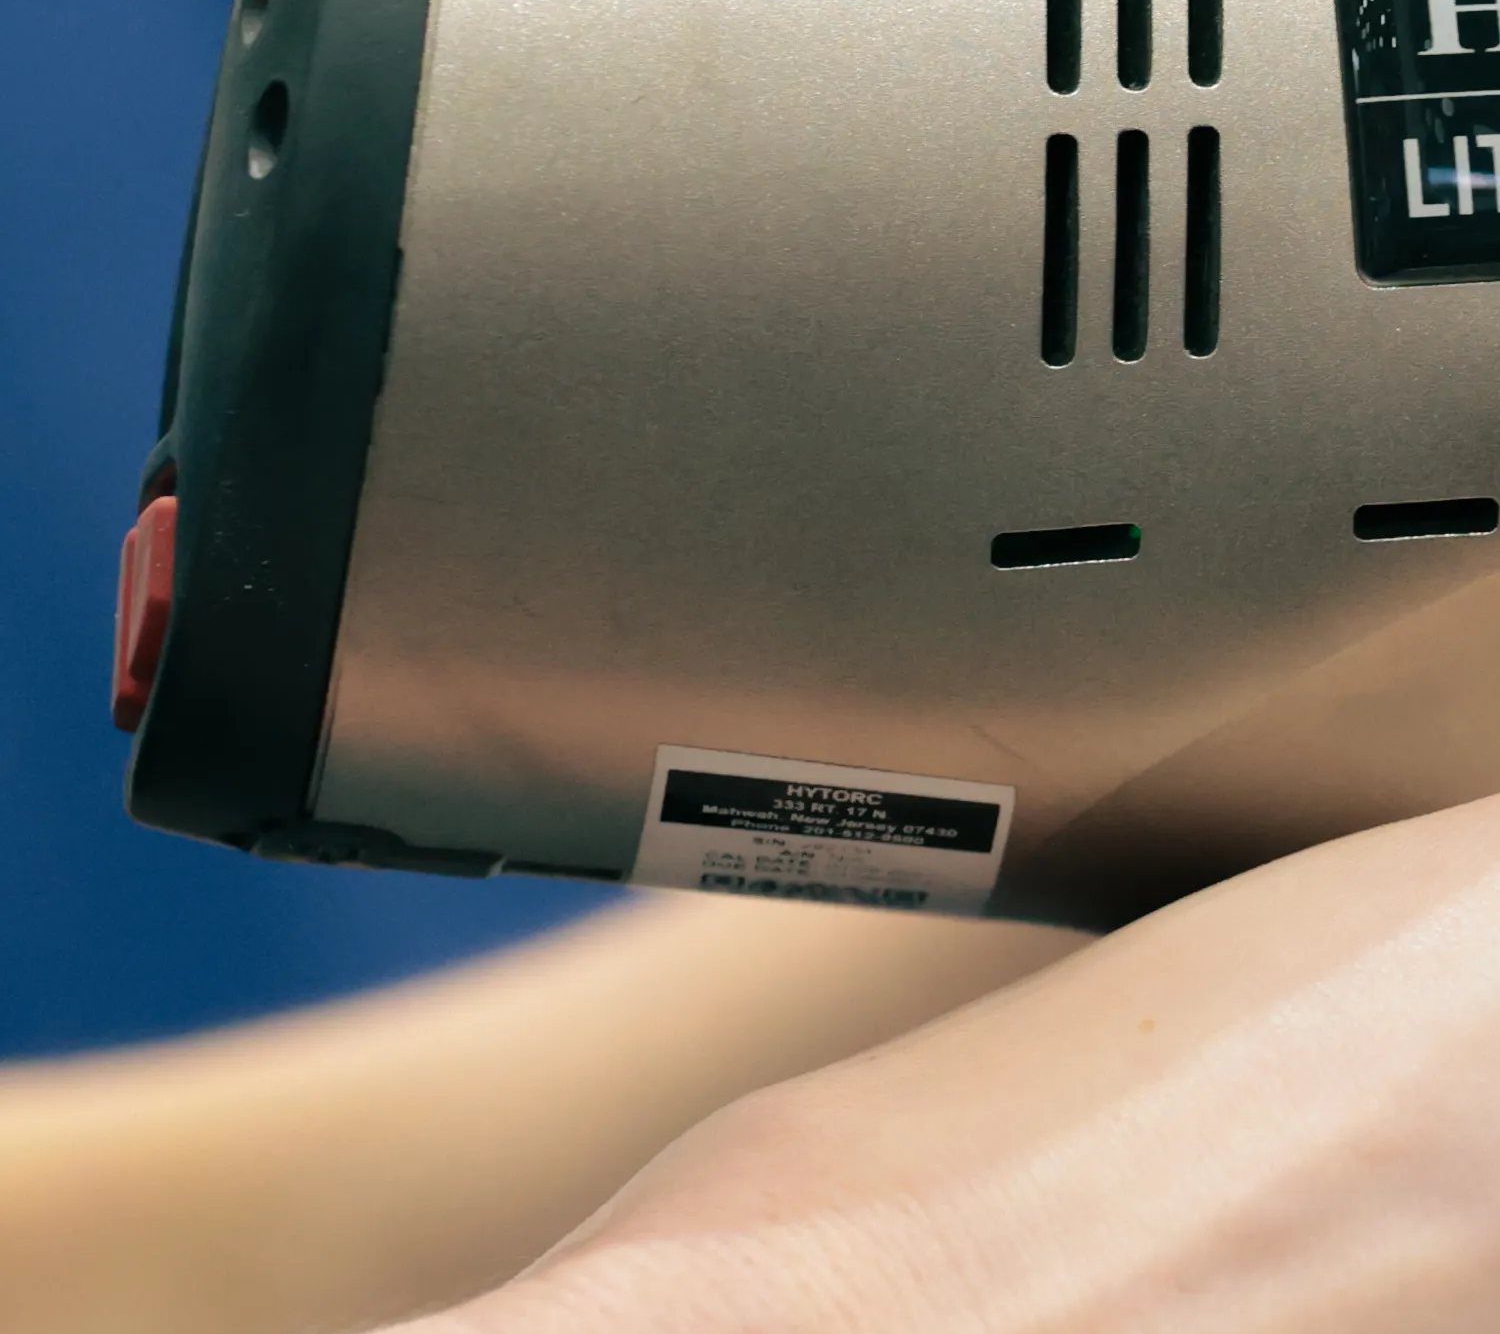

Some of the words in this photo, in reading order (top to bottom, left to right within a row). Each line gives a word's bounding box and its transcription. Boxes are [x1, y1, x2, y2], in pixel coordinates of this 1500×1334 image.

[786, 784, 883, 806] HYTORC
[773, 798, 805, 812] 333
[847, 806, 867, 818] 17
[790, 812, 831, 826] New
[836, 817, 898, 834] Jersey
